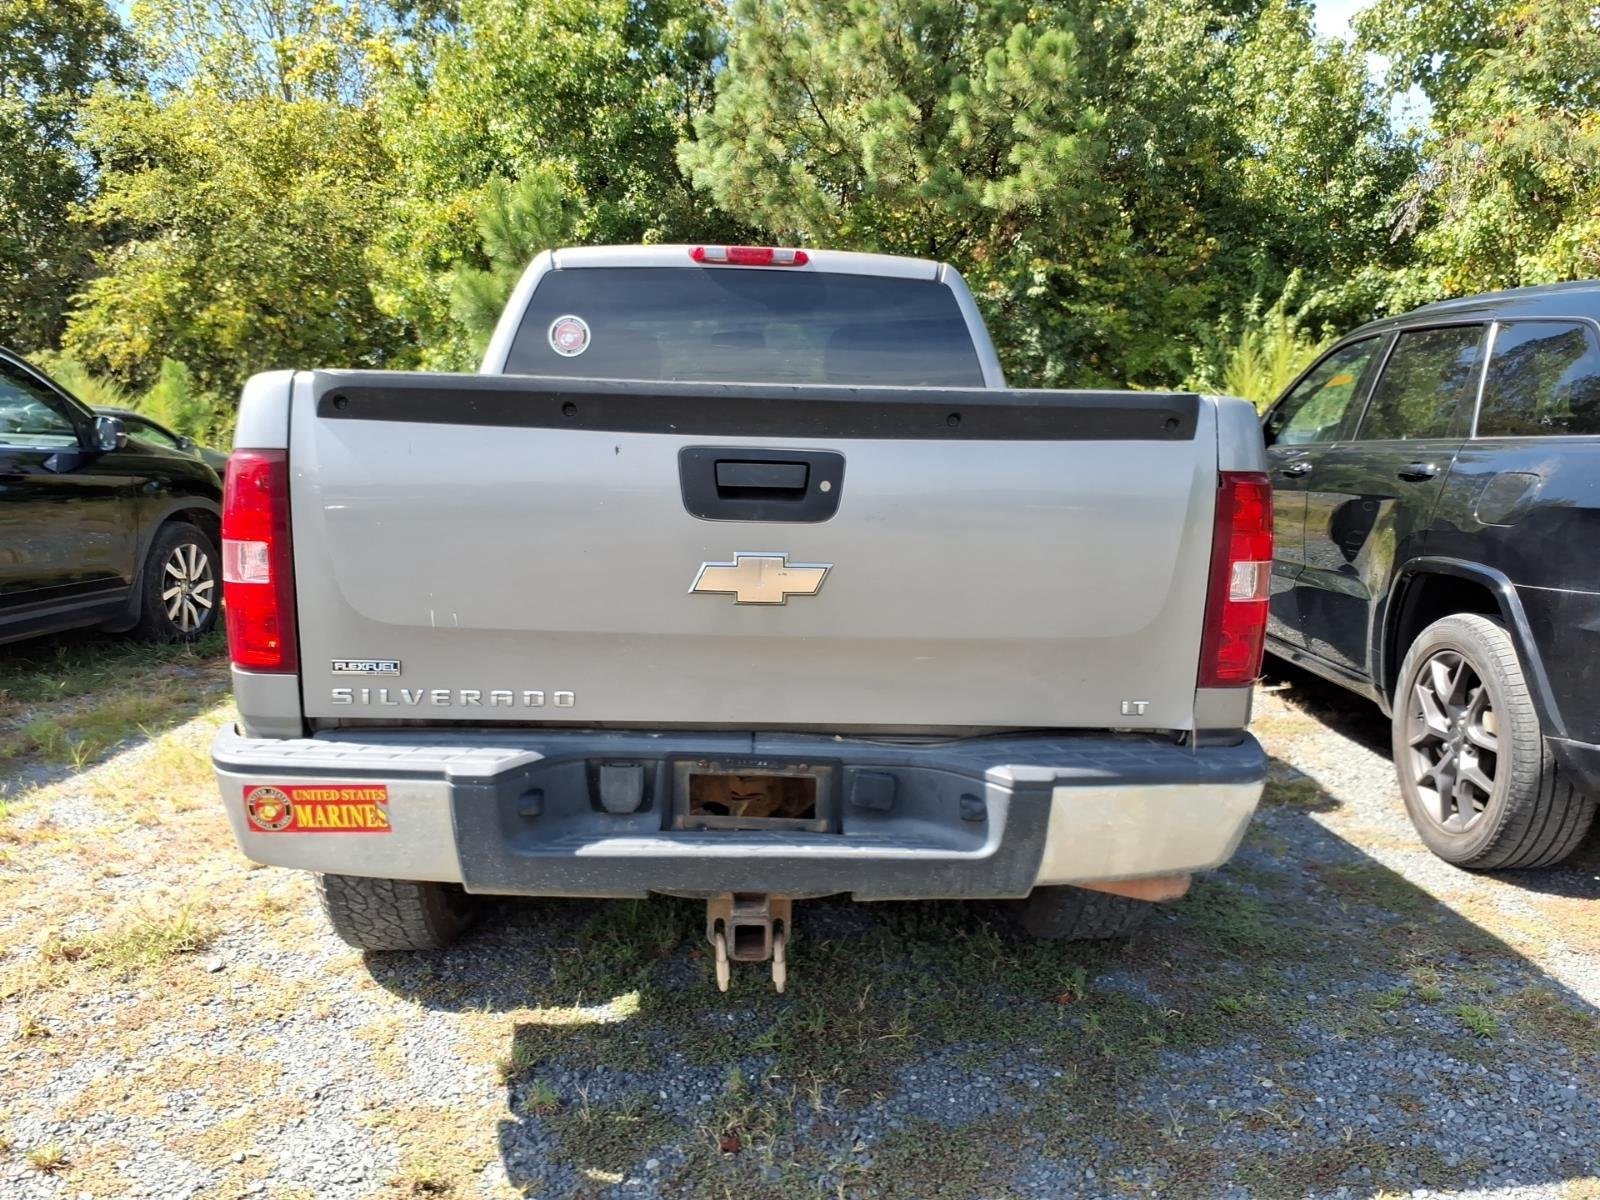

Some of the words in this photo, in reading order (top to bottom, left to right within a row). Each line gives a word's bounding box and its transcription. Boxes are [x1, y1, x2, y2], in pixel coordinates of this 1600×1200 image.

[334, 661, 399, 671] FLEXFUEL
[331, 688, 576, 708] SILVERADO
[1121, 700, 1150, 716] LT
[292, 789, 340, 801] UNITED
[340, 789, 387, 801] STATES
